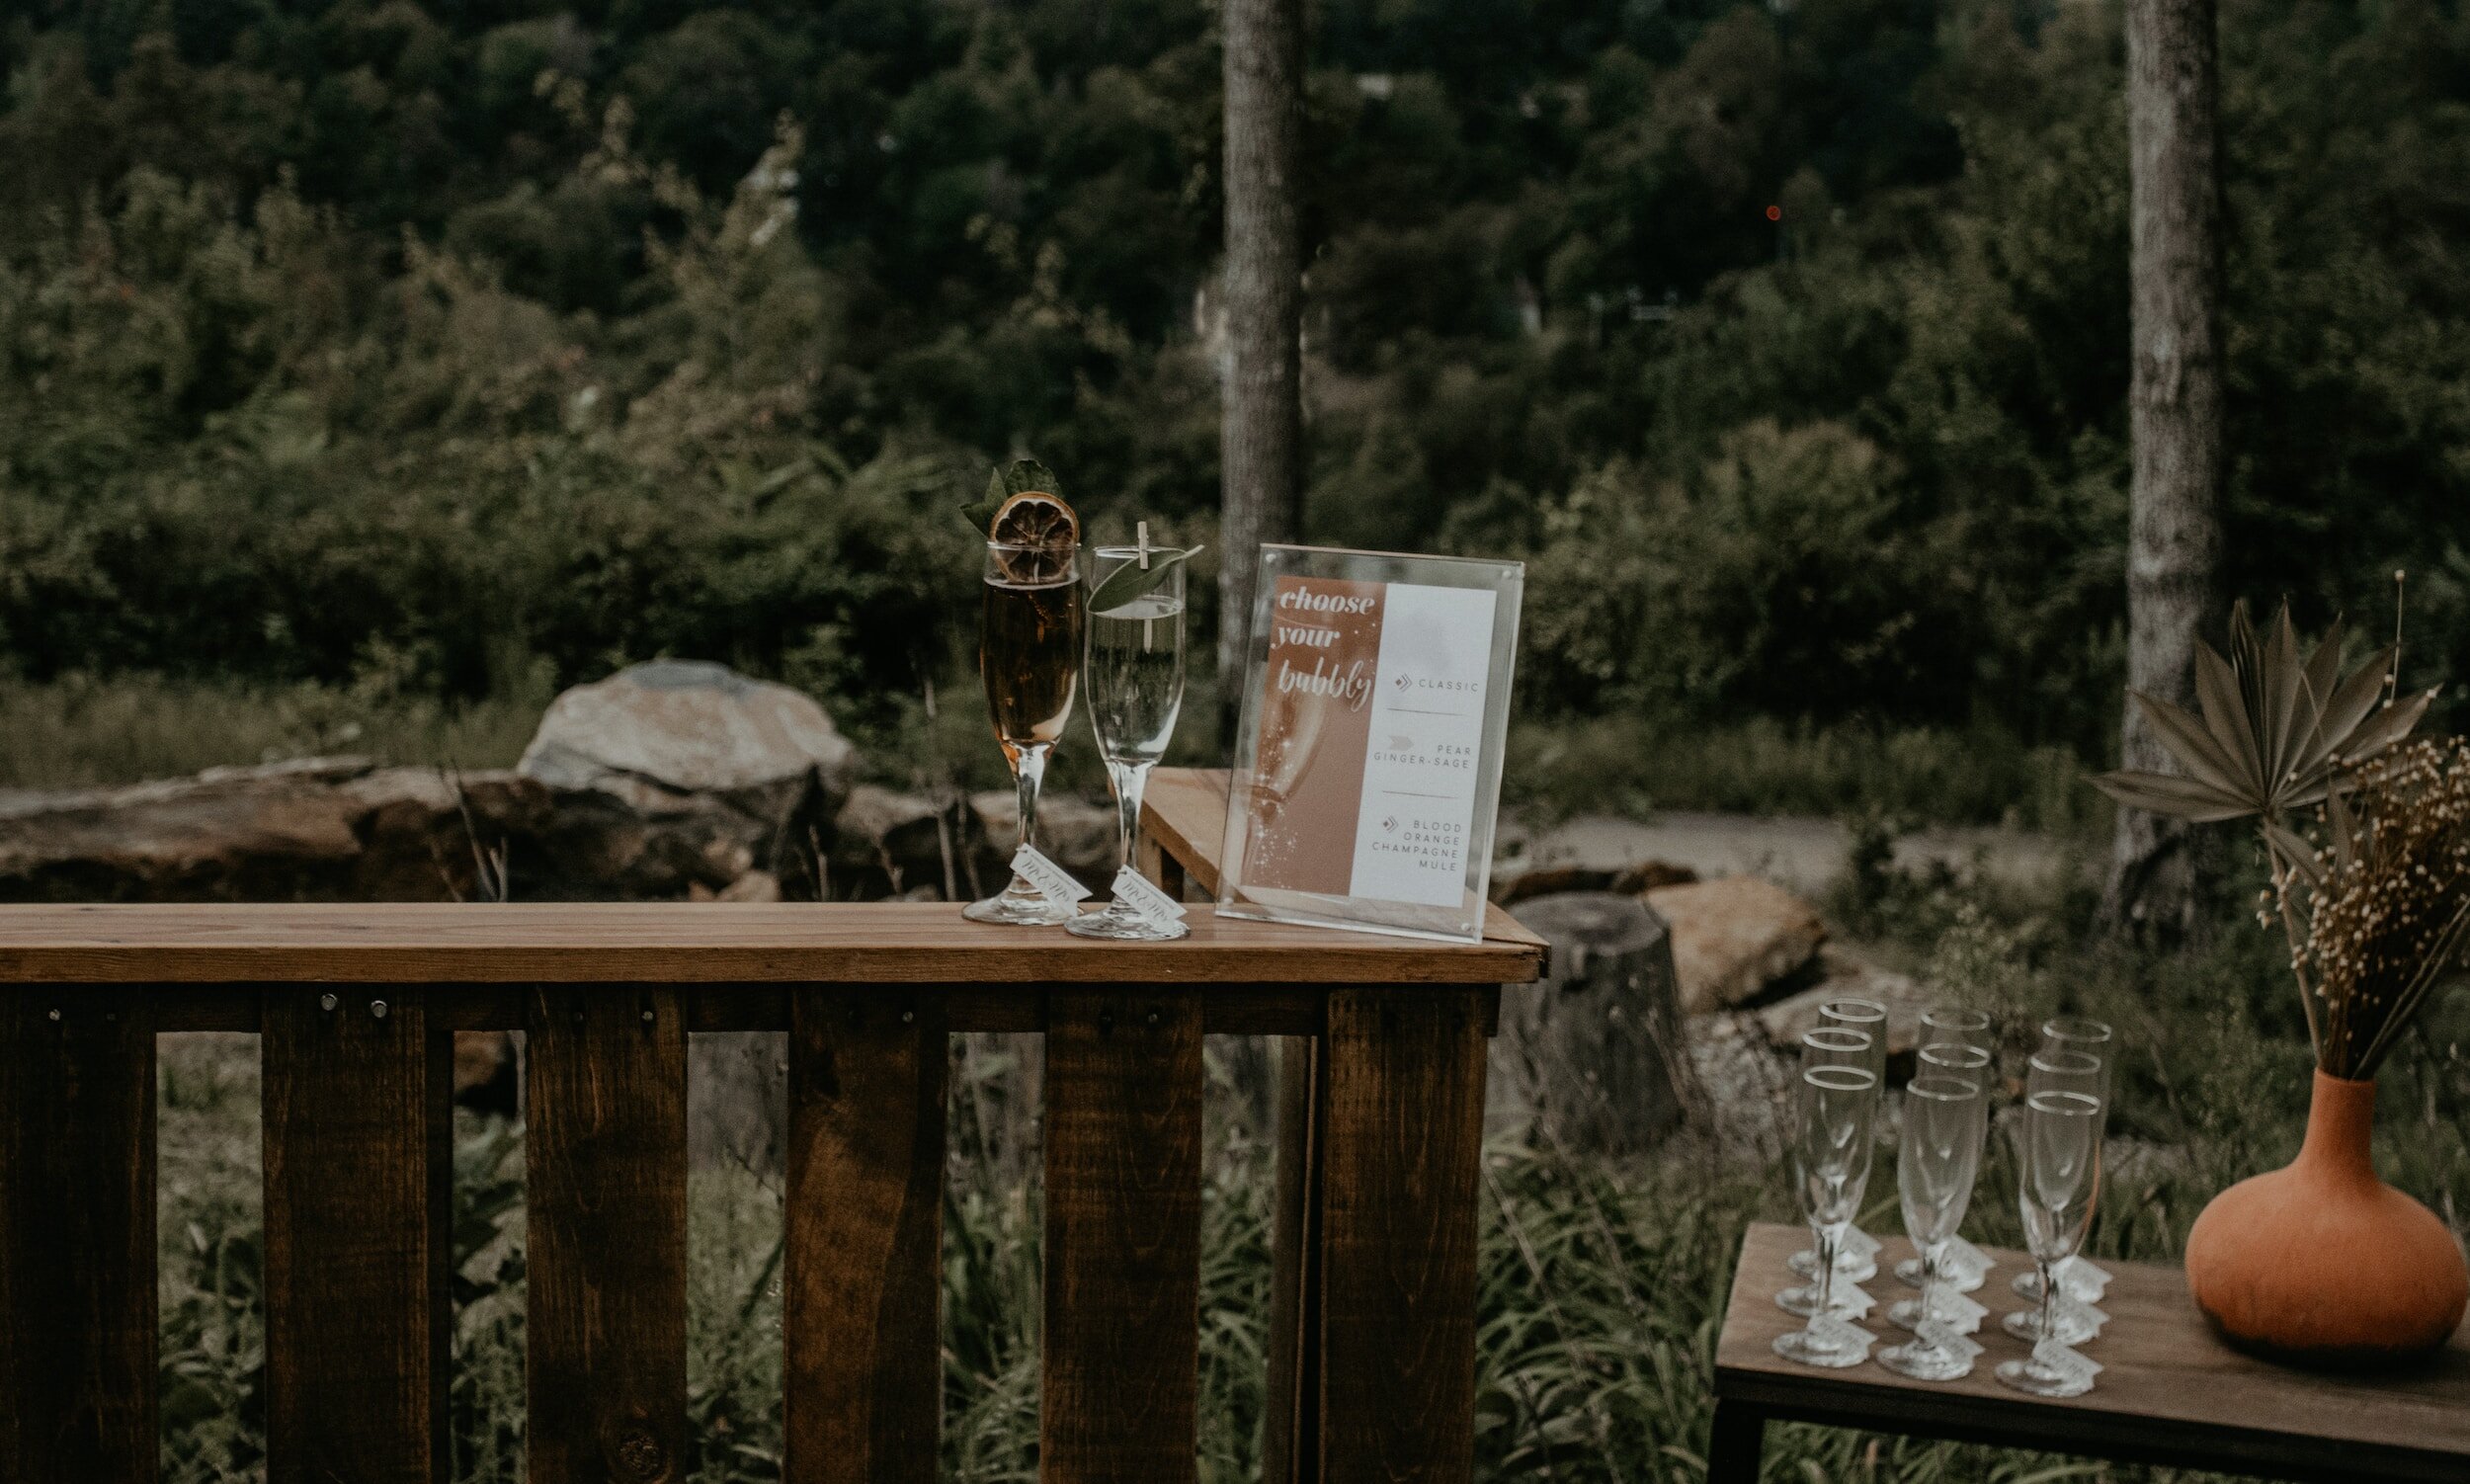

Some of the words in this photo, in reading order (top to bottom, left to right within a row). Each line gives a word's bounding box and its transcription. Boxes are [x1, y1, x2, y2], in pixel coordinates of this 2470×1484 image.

[1279, 586, 1375, 615] choose
[1271, 626, 1341, 649] your
[1278, 656, 1371, 712] bubbly
[1419, 679, 1478, 693] CLASSIC
[1438, 744, 1471, 756] PEAR
[1413, 820, 1461, 833] BLOOD
[1403, 832, 1459, 846] ORANGE
[1372, 842, 1457, 859] CHAMPAGNE
[1419, 860, 1456, 871] MULE
